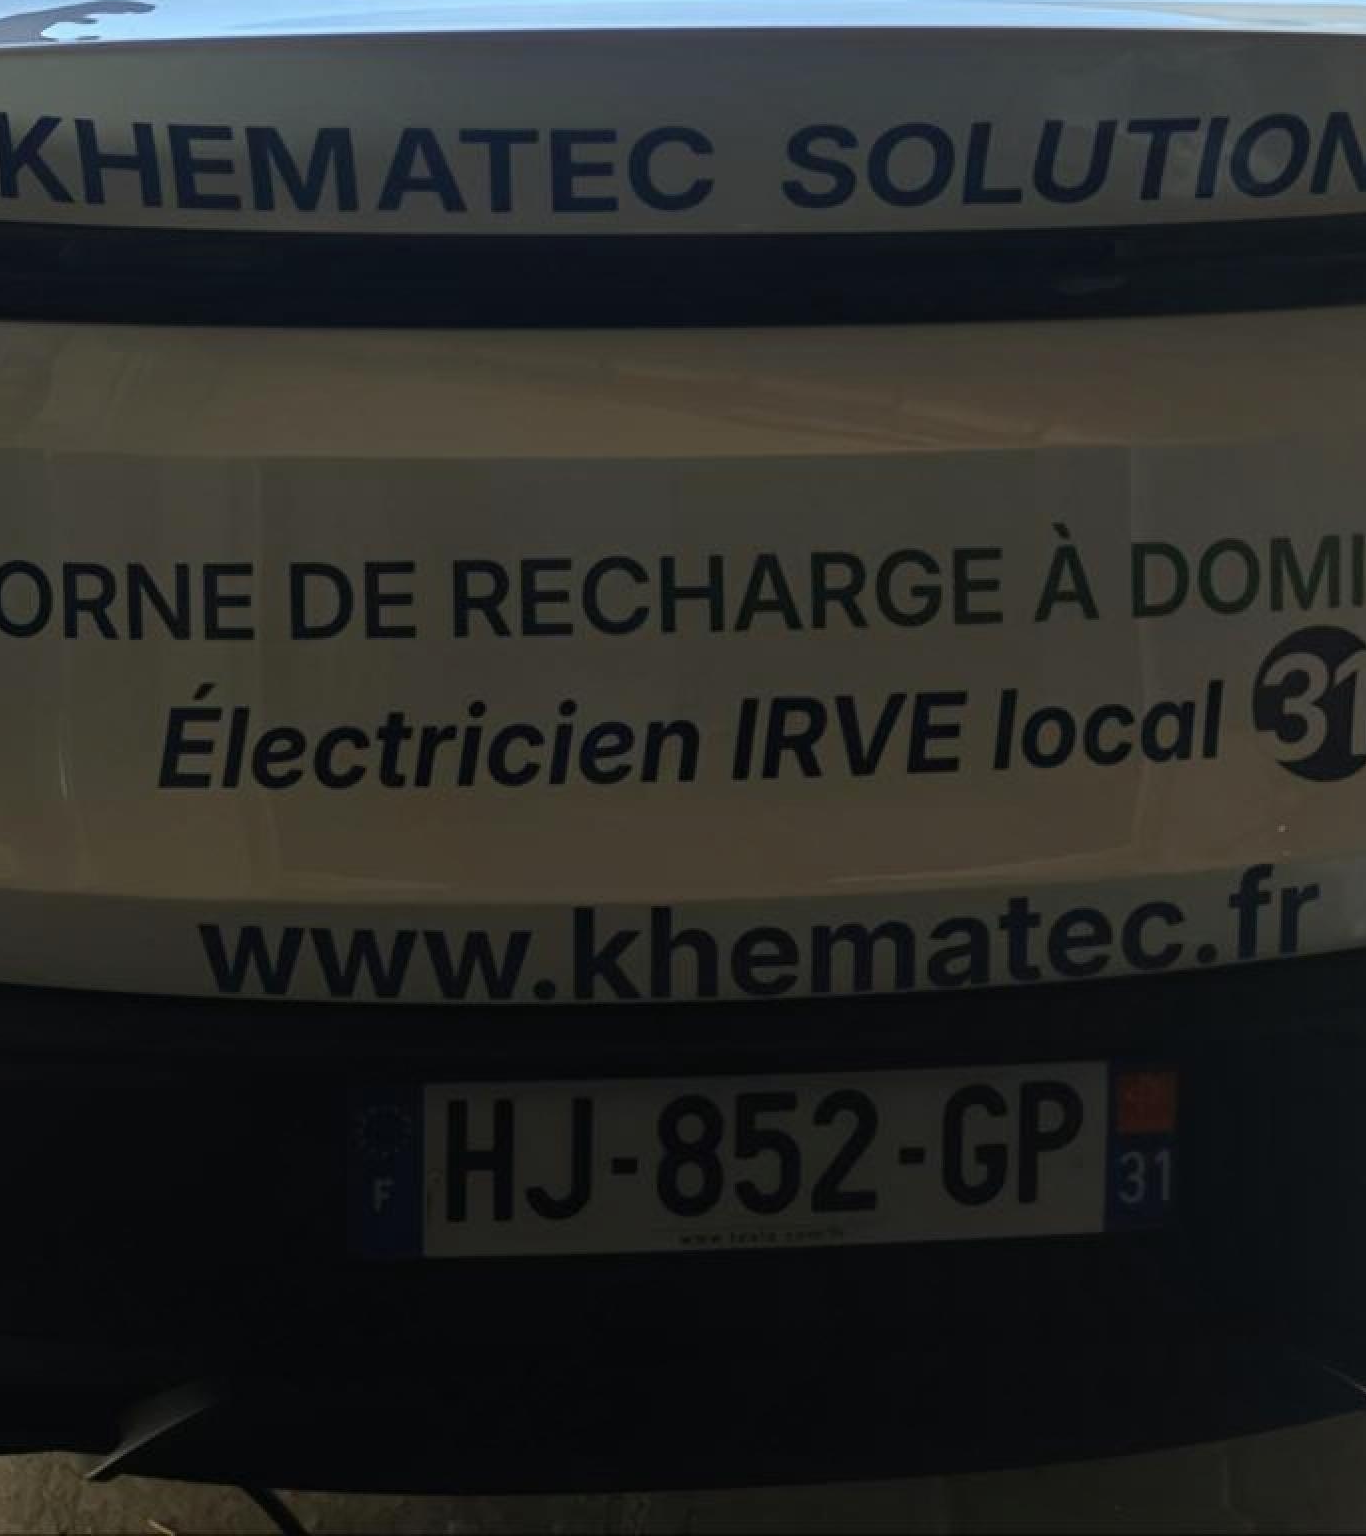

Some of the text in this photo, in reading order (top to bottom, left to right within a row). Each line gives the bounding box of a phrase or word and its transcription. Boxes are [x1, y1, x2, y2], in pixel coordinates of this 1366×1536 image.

[290, 561, 417, 640] DE
[453, 547, 1004, 638] RECHARGE
[1034, 523, 1100, 623] À
[158, 683, 701, 789] Électricien
[732, 690, 968, 781] IRVE
[993, 679, 1225, 771] local
[198, 864, 1320, 1003] www.khematec.fr
[371, 1080, 1173, 1222] F HJ-852-GP 31
